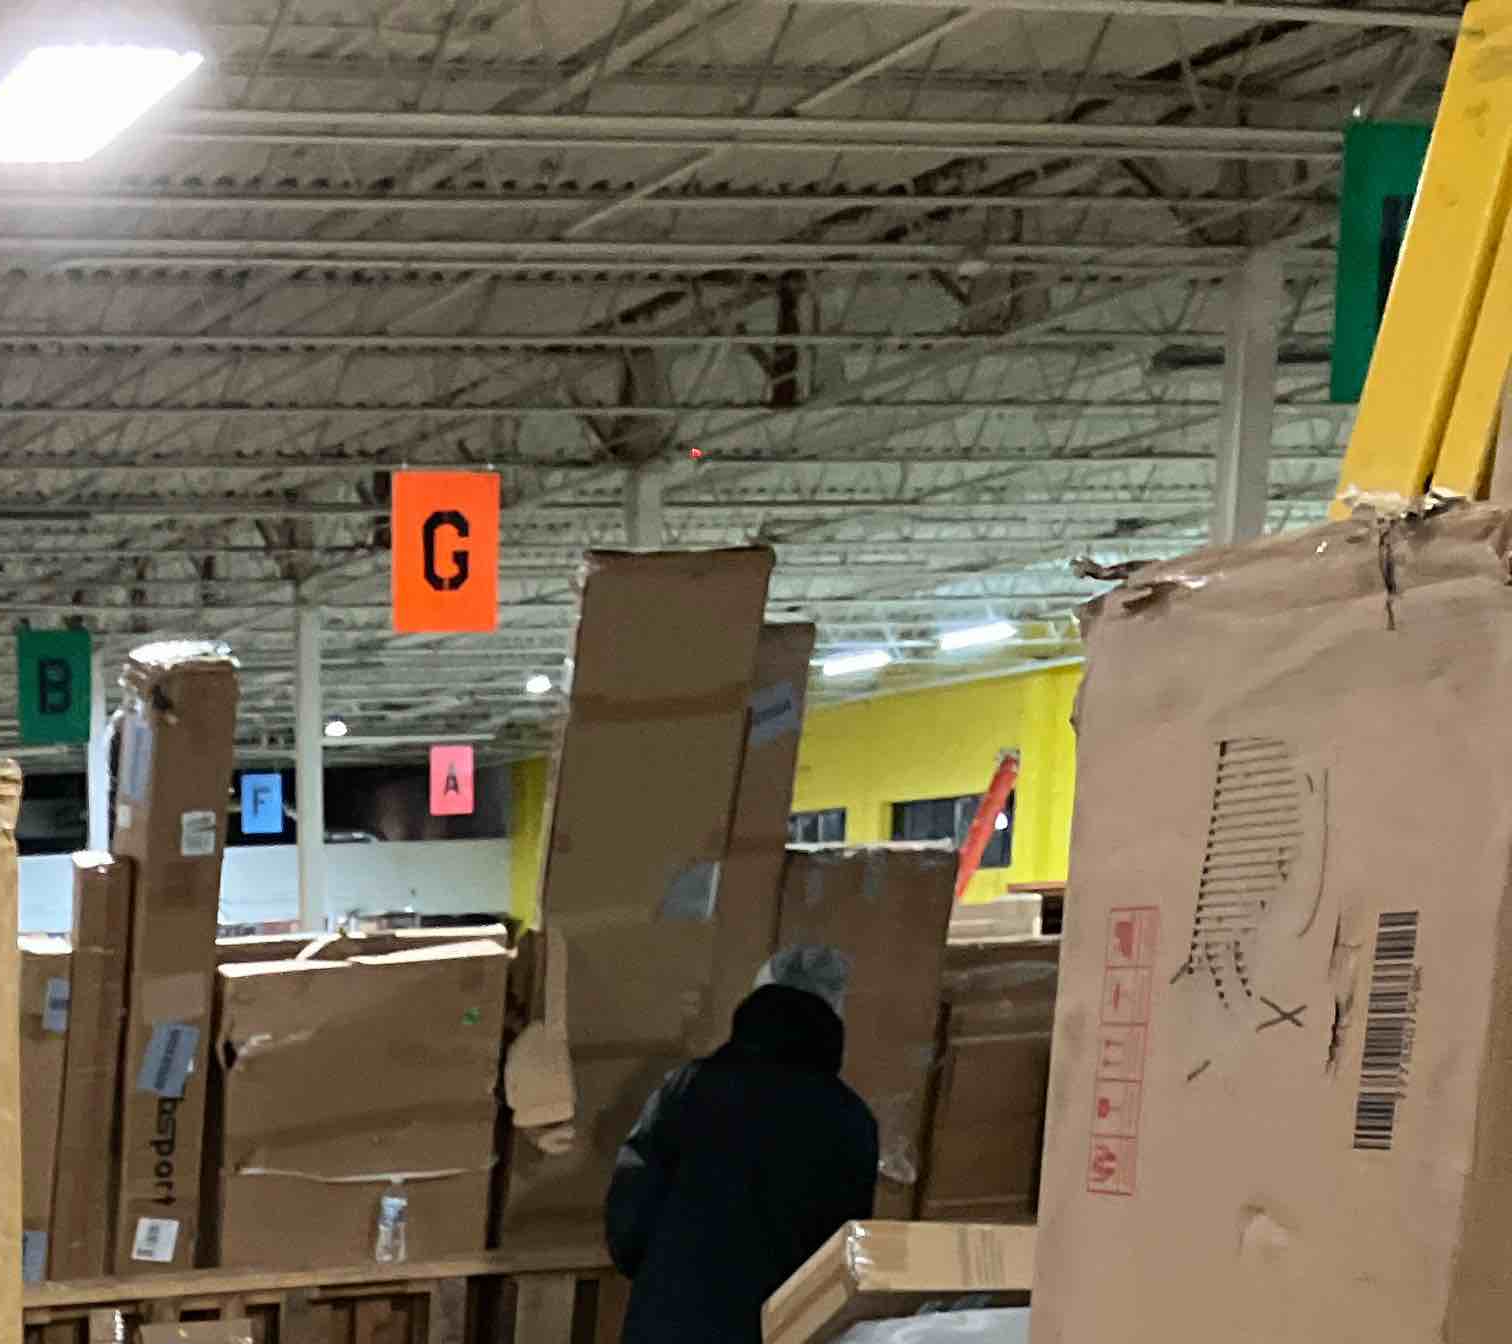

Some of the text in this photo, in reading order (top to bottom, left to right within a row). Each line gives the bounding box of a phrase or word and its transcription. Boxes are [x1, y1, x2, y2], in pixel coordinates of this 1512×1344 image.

[422, 510, 471, 592] G
[39, 658, 71, 714] B
[253, 785, 271, 816] F
[443, 760, 460, 796] A
